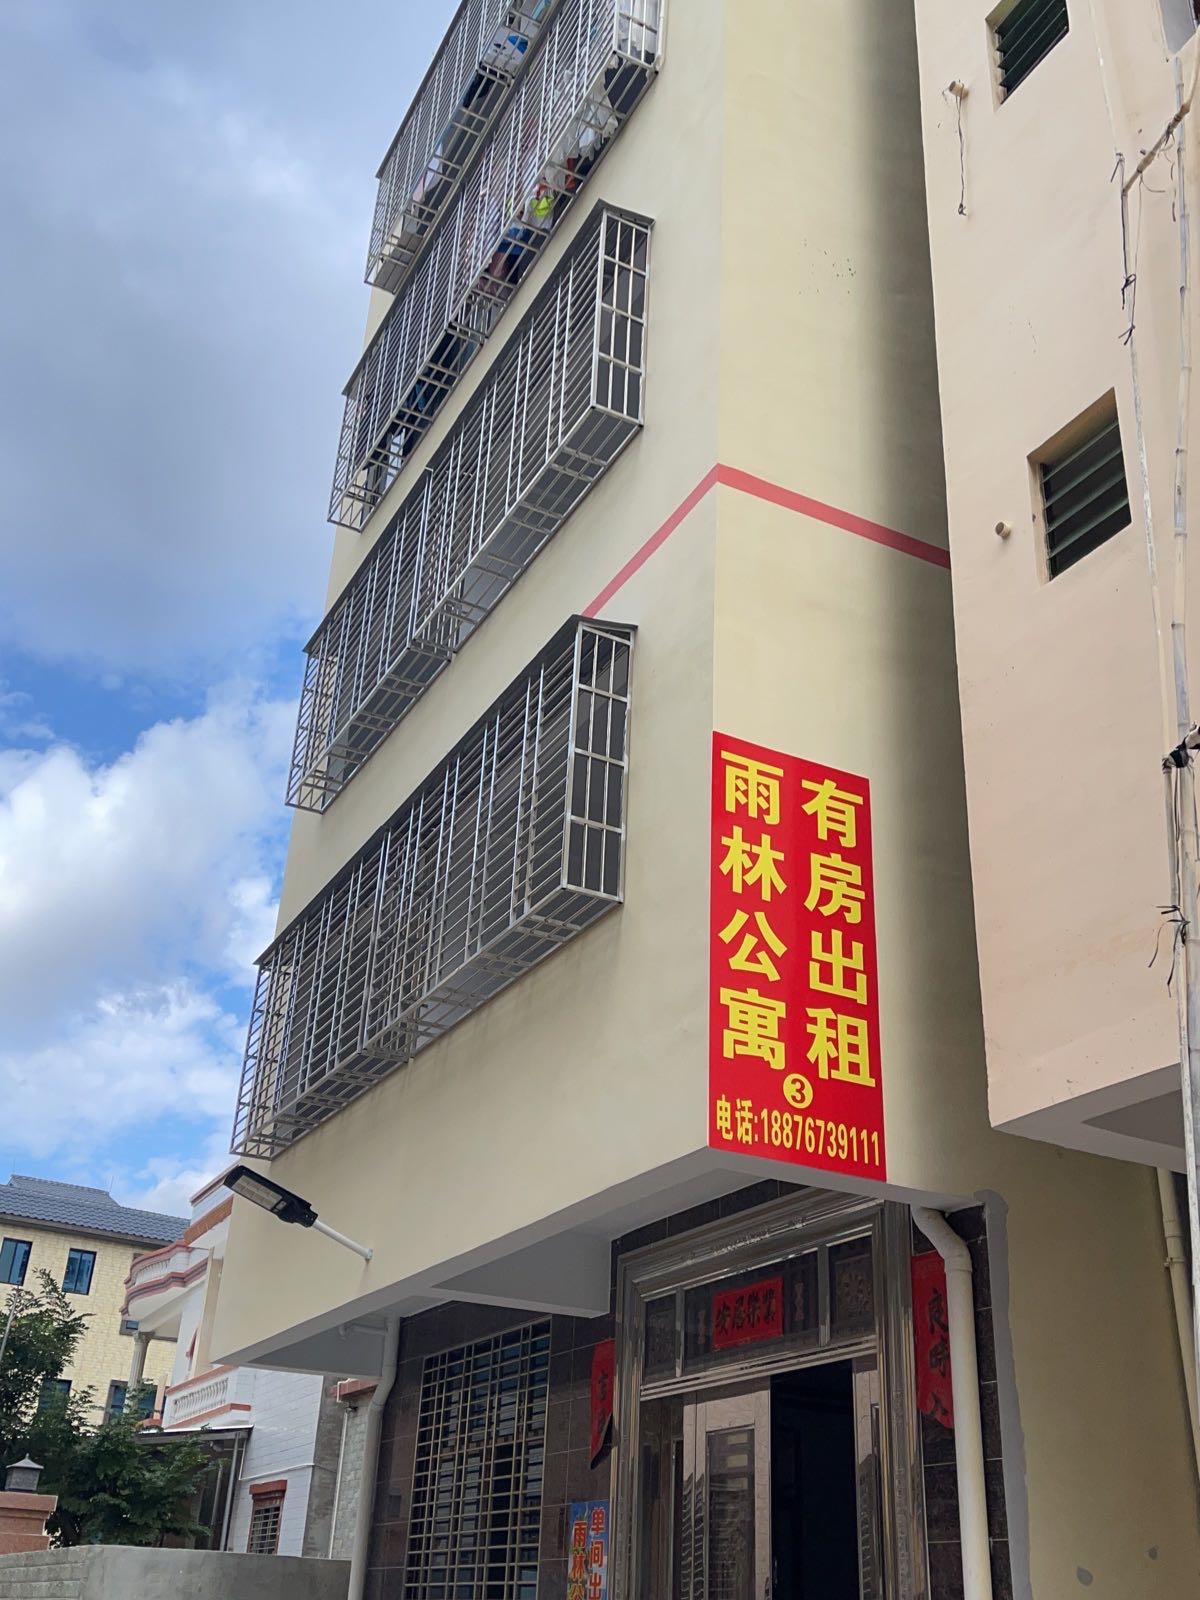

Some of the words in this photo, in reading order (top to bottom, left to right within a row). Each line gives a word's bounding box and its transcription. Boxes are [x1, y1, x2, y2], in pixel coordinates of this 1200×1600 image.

[719, 750, 787, 1070] 雨林公寓
[801, 779, 876, 1088] 有房出租
